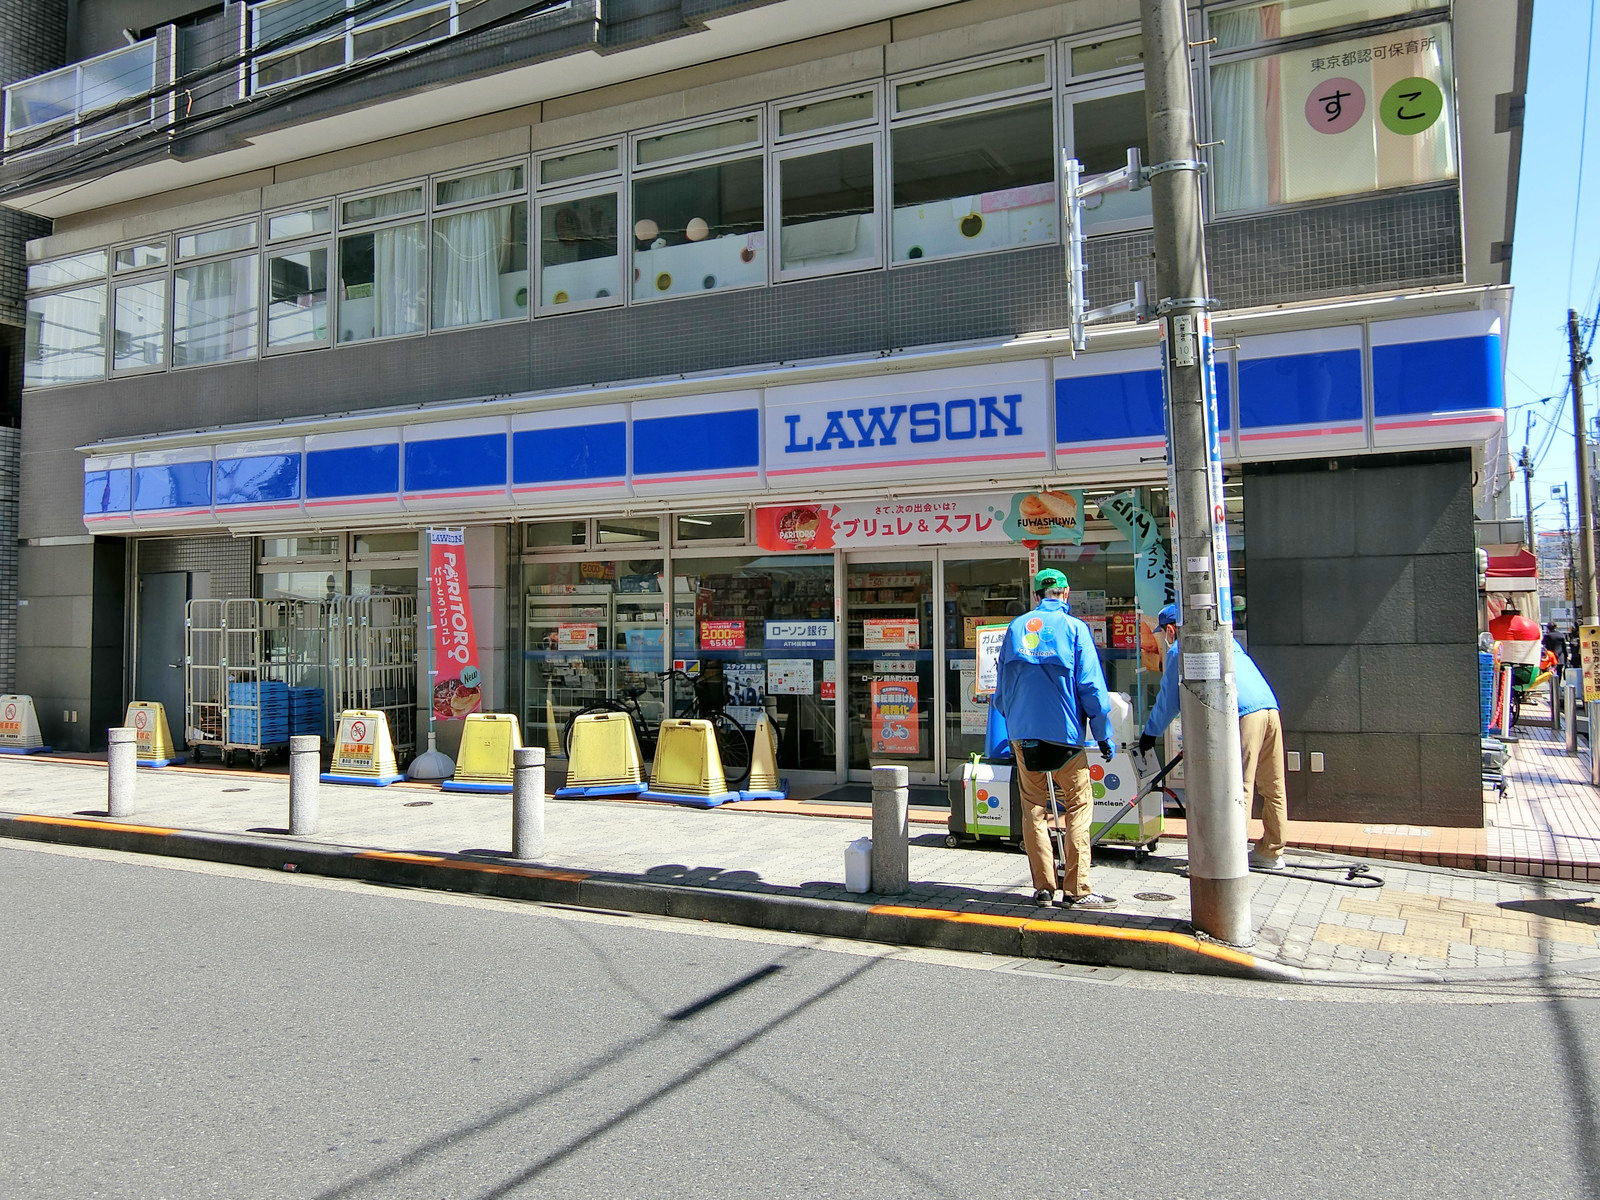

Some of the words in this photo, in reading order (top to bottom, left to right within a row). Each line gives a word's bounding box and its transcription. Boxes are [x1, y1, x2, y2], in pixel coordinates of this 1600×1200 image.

[1310, 36, 1436, 72] 東京都認可保育所
[1319, 90, 1351, 122] す
[1397, 92, 1426, 119] こ
[784, 394, 1023, 453] LAWSON
[875, 502, 957, 515] さて、次の出会いは?
[843, 517, 913, 538] ブリュレ
[934, 513, 993, 534] スフレ
[1017, 516, 1077, 528] FUWASHUWA
[432, 534, 462, 543] LAWSON
[780, 530, 816, 540] PARITORO
[443, 552, 470, 664] PARITORO
[701, 629, 731, 640] 2,000
[772, 625, 828, 636] ローソン銀行
[464, 670, 478, 685] New
[1093, 799, 1124, 807] umclean
